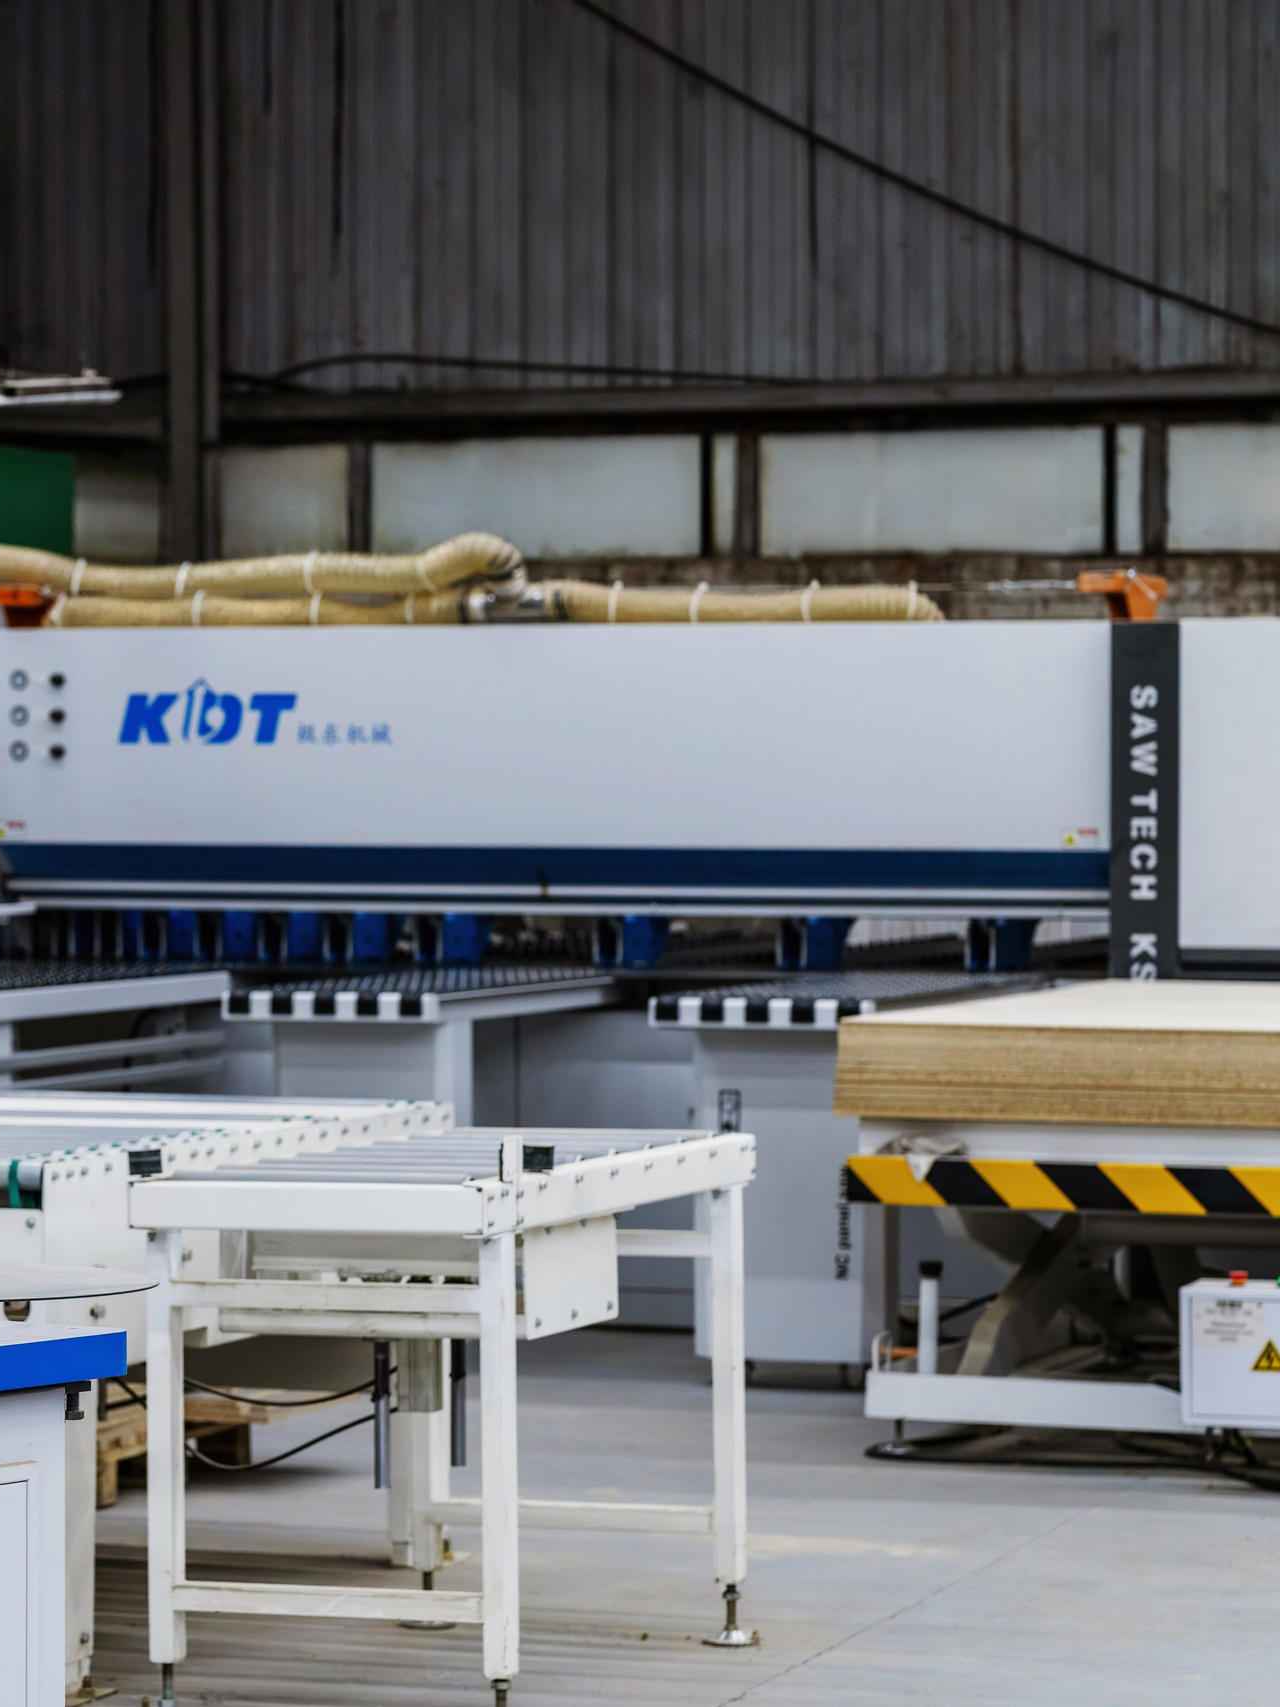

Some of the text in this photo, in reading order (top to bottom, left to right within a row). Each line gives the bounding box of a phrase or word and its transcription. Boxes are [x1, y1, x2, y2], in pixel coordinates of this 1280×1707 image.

[119, 677, 298, 746] KDT
[1130, 684, 1158, 777] SAW
[1130, 788, 1158, 901] TECH
